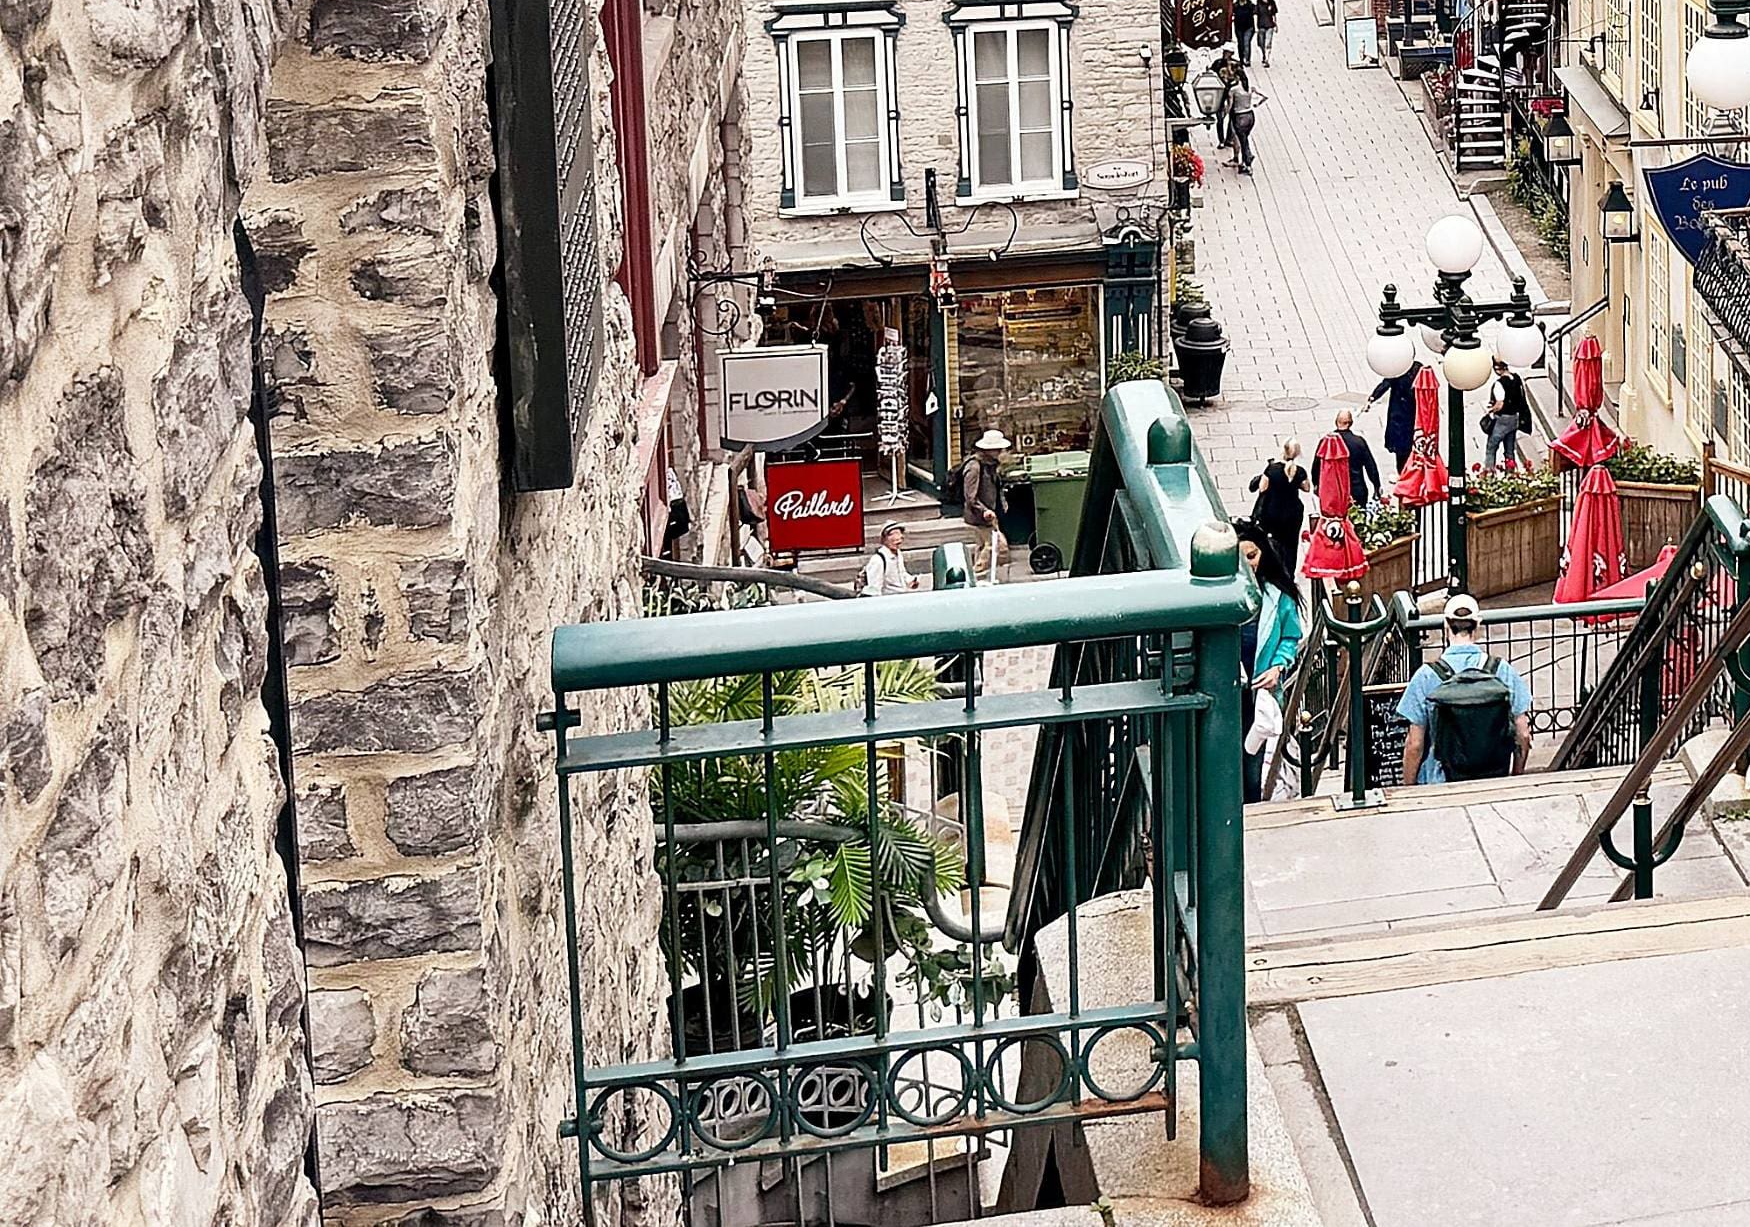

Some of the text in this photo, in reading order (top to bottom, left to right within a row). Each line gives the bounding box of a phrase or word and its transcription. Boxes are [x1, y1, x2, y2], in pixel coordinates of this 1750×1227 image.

[1679, 174, 1728, 192] Le pub
[729, 389, 819, 411] FLORIN
[774, 490, 854, 520] Paillard
